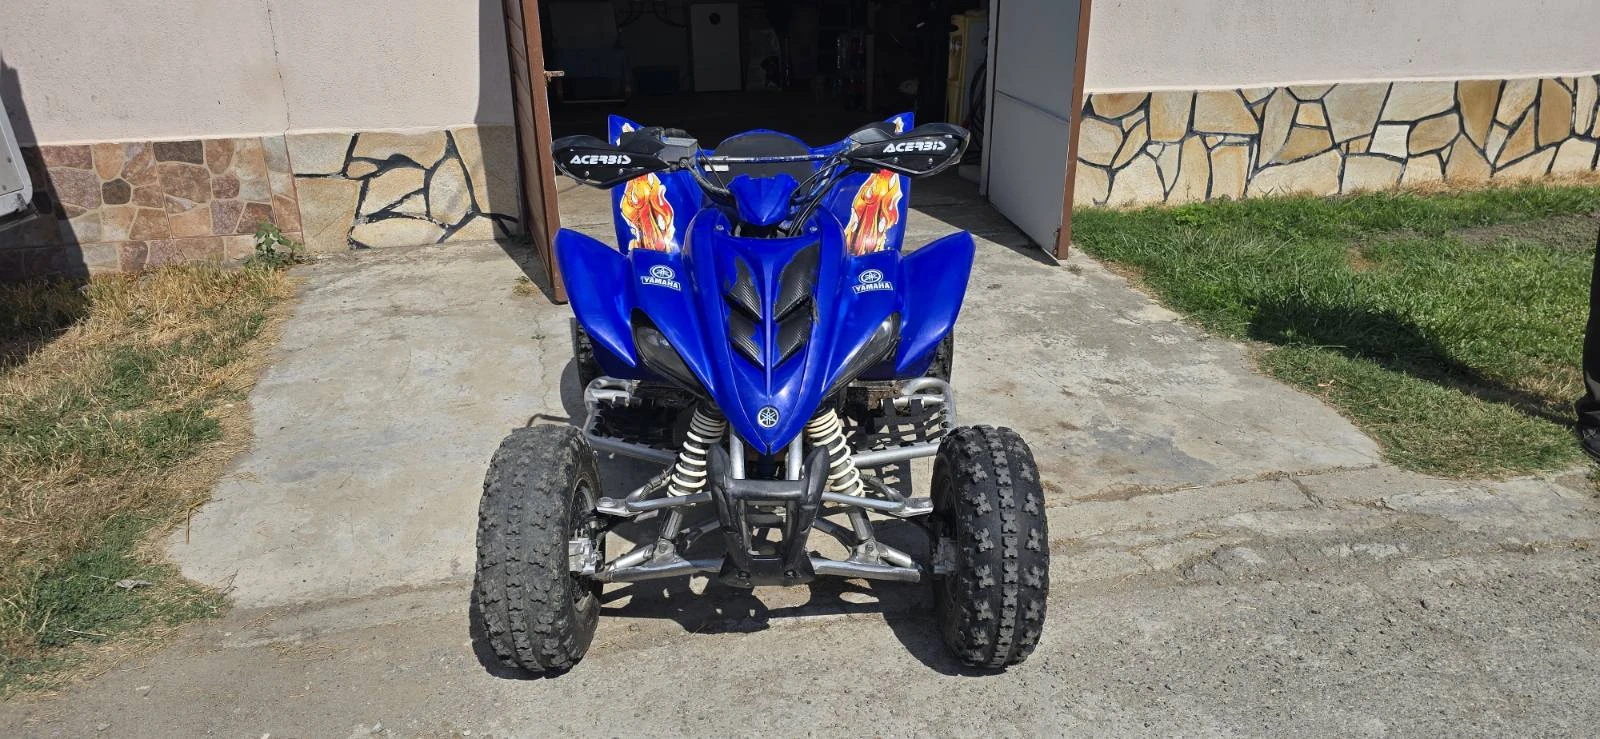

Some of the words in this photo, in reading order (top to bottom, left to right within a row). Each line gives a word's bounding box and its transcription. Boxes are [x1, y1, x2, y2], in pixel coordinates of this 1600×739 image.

[882, 141, 947, 153] ACERBIS
[570, 154, 632, 165] ACERBIS
[644, 276, 679, 289] YAMAHA
[855, 282, 891, 292] YAMAHA
